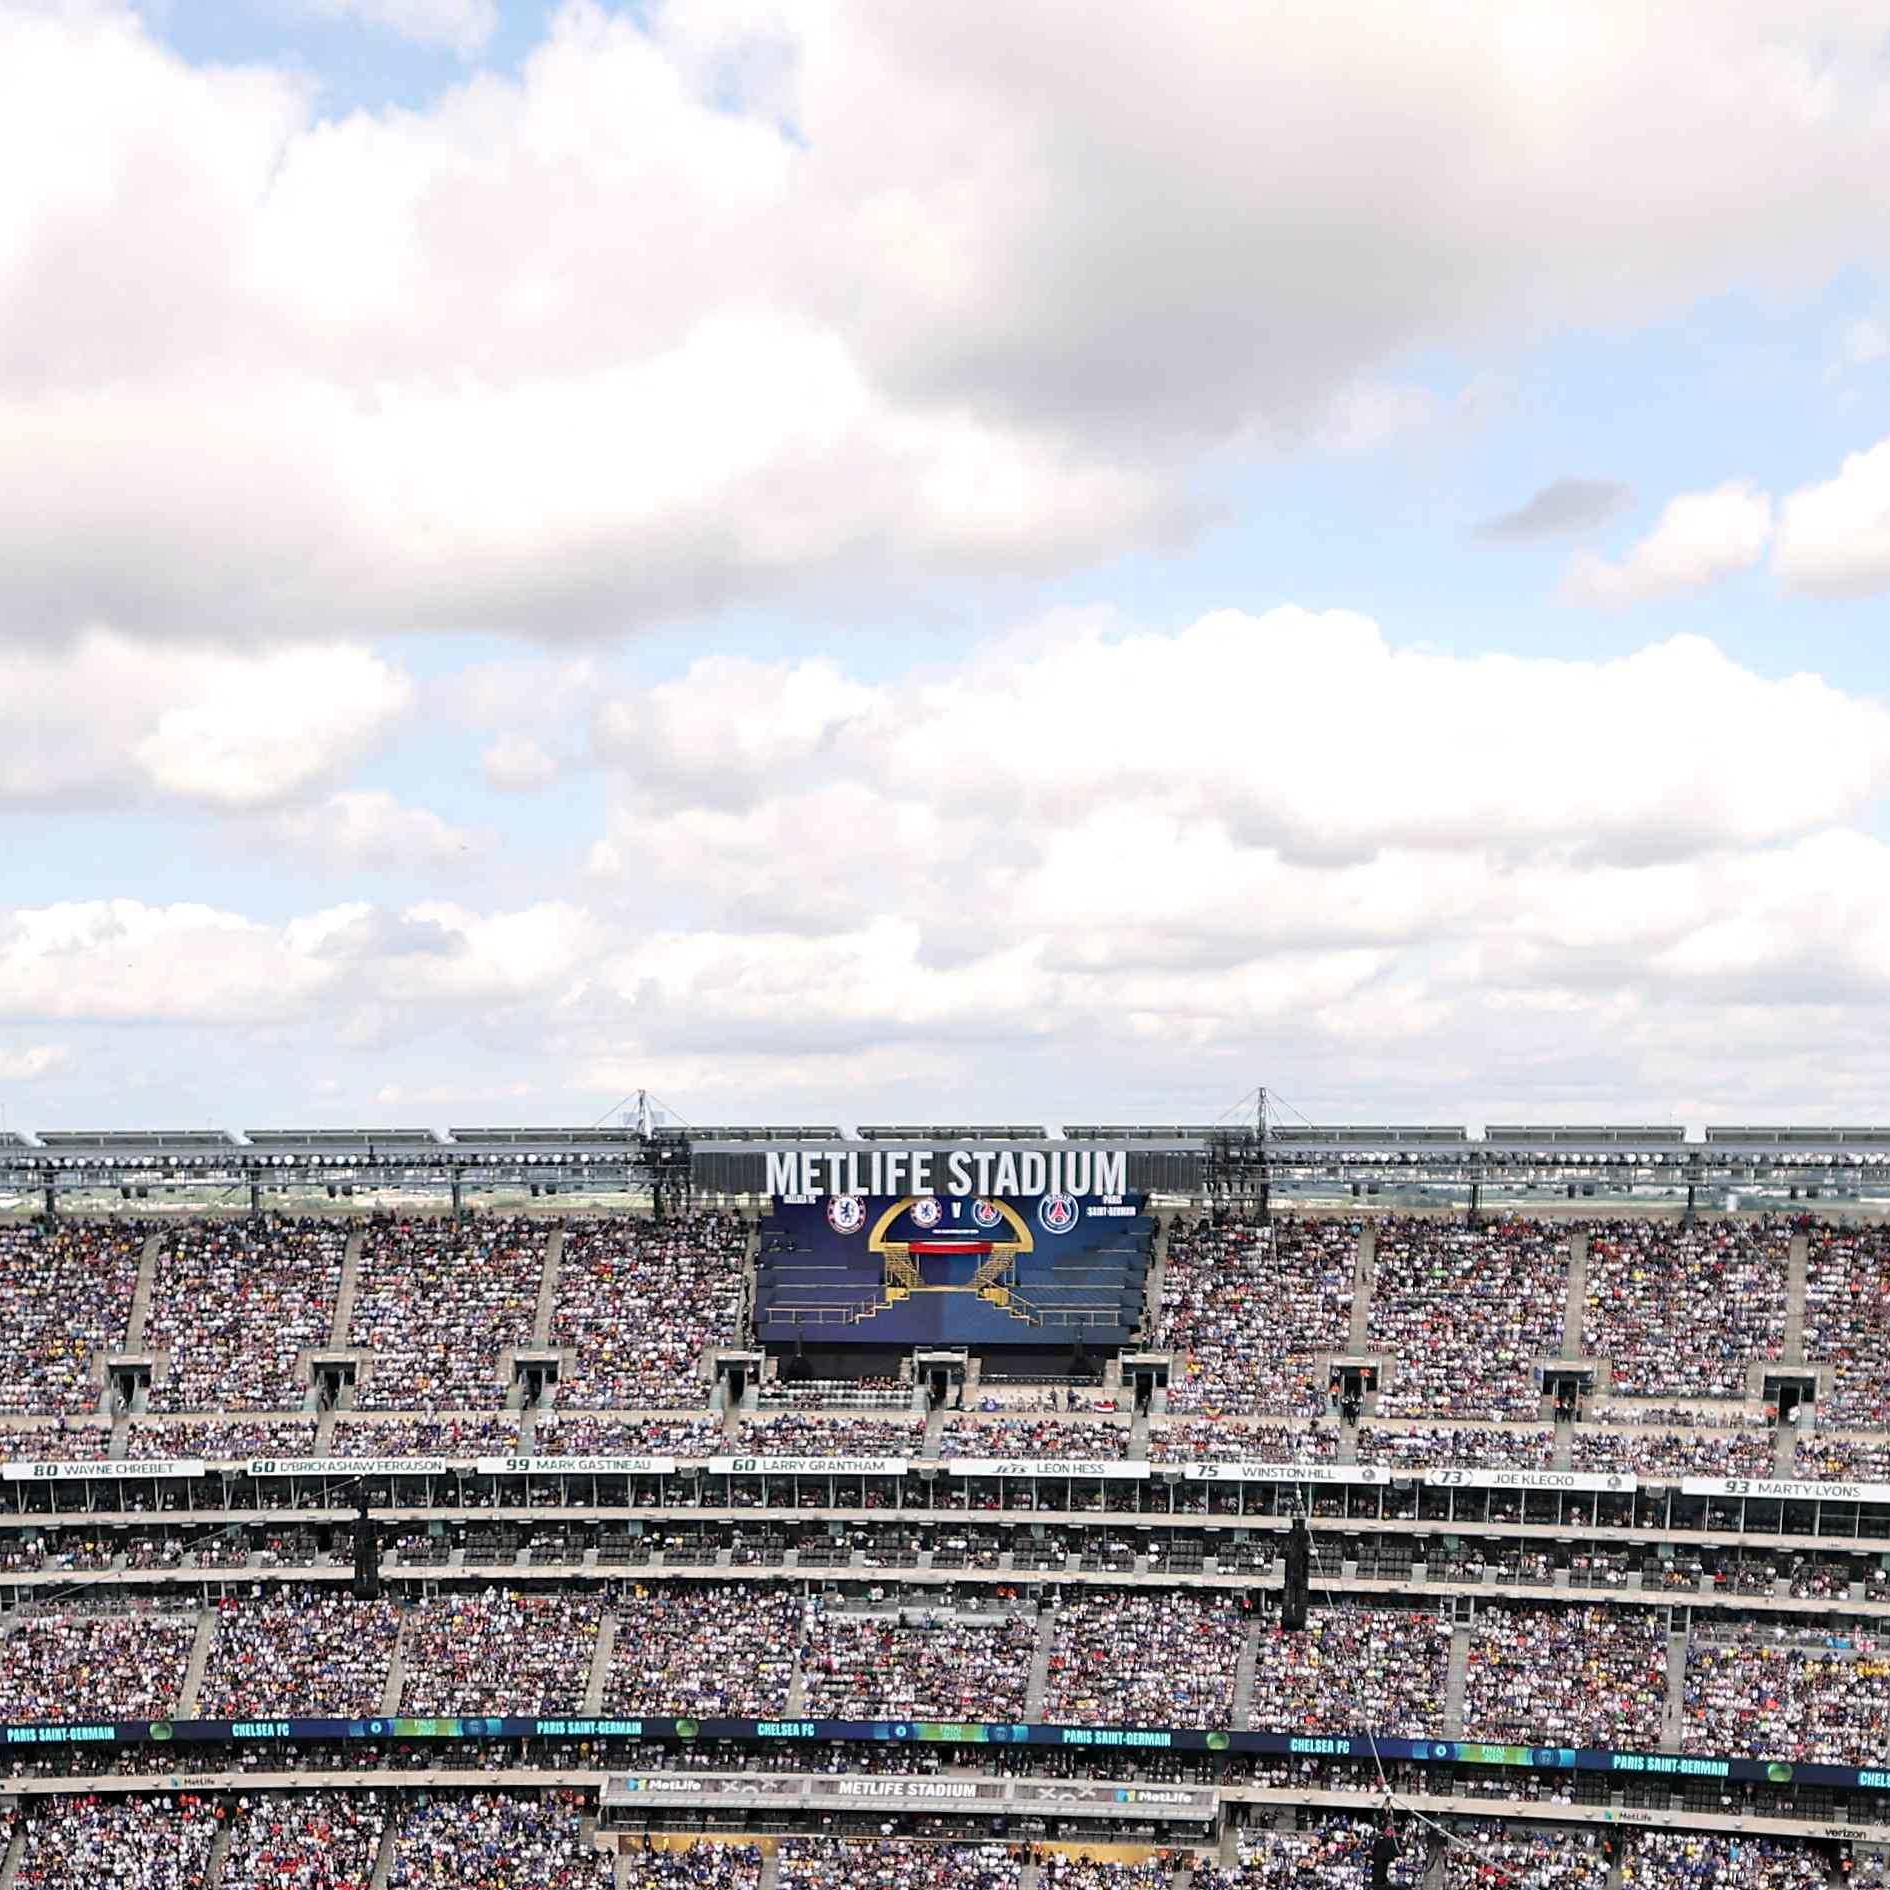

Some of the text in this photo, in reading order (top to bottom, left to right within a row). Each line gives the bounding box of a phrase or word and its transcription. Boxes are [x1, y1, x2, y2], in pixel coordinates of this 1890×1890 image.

[766, 1150, 1127, 1197] METLIFE STADIUM
[952, 1202, 961, 1218] V
[64, 1463, 112, 1475] WAYNE
[116, 1462, 174, 1474] CHREBET
[252, 1461, 275, 1473] 60
[506, 1459, 651, 1471] 99 MARK GASTINEAU
[732, 1459, 885, 1471] 60 LARRY GRANTHAM
[1037, 1463, 1069, 1474] LEON
[1073, 1463, 1105, 1475] HESS
[1197, 1465, 1336, 1480] 75 WINSTON HILL
[1439, 1470, 1574, 1487] 73 JOE KLECKO
[1724, 1480, 1861, 1498] 93 MARTY LYONS
[8, 1725, 114, 1742] PARIS SAINT-GERMAIN
[232, 1721, 290, 1737] CHELSEA FC
[537, 1721, 642, 1735] PARIS SAINT-GERMAIN
[758, 1722, 815, 1737] CHELSEA FC
[1063, 1729, 1171, 1747] PARIS SAINT-GERMAIN
[1291, 1738, 1350, 1755] CHELSEA FC
[1614, 1755, 1729, 1777] PARIS SAINT-GERMAIN
[184, 1777, 215, 1786] MetLife
[649, 1778, 701, 1792] MetLife
[839, 1781, 976, 1798] METLIFE STADIUM
[1139, 1790, 1192, 1804] MetLife
[1620, 1810, 1652, 1822] MetLife
